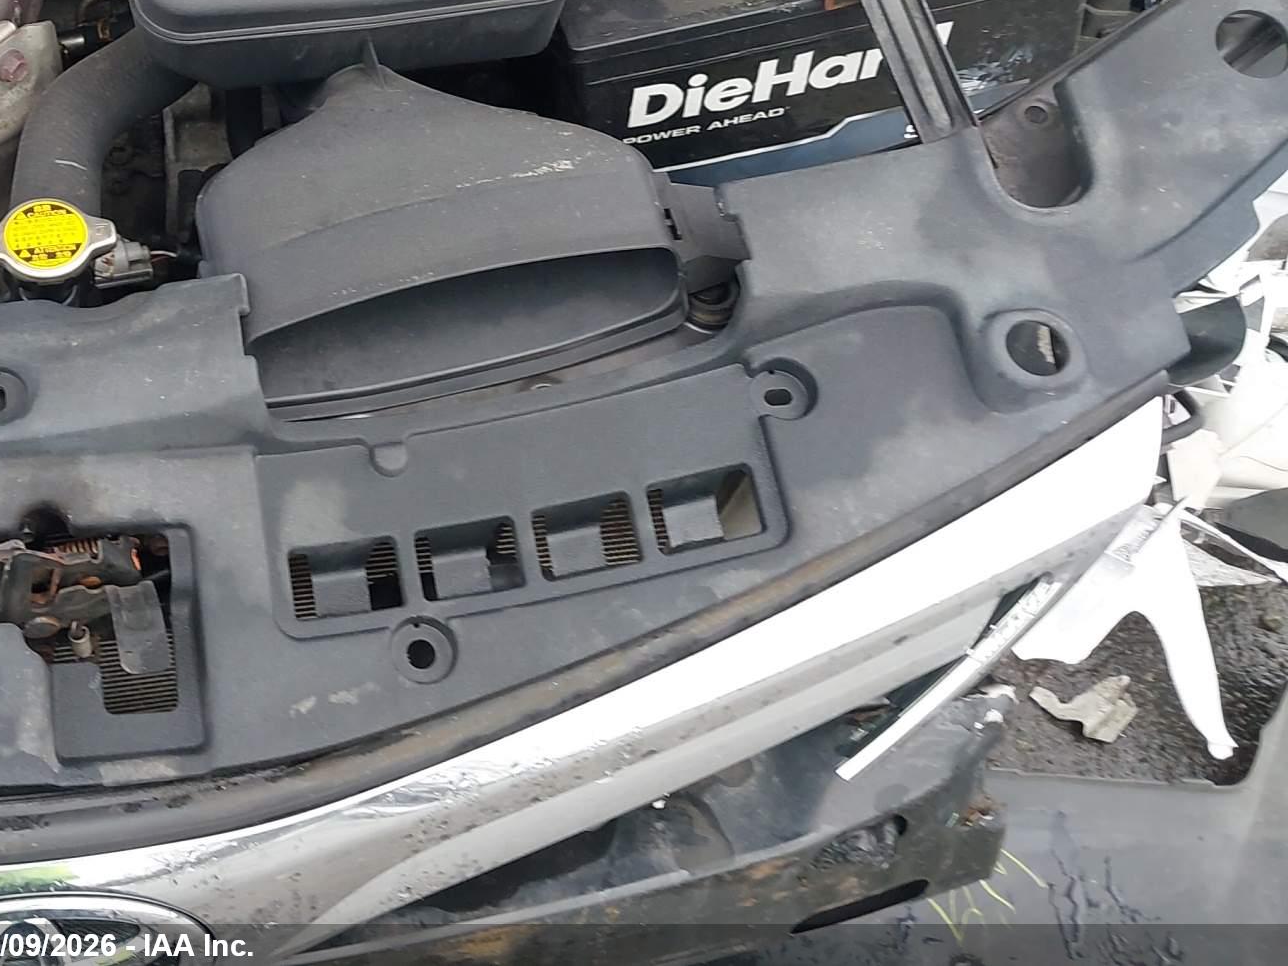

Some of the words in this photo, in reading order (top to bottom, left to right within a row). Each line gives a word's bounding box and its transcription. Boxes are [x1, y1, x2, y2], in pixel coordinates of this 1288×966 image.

[626, 21, 954, 129] DieHar
[623, 125, 701, 144] POWER
[706, 107, 785, 132] AHEAD
